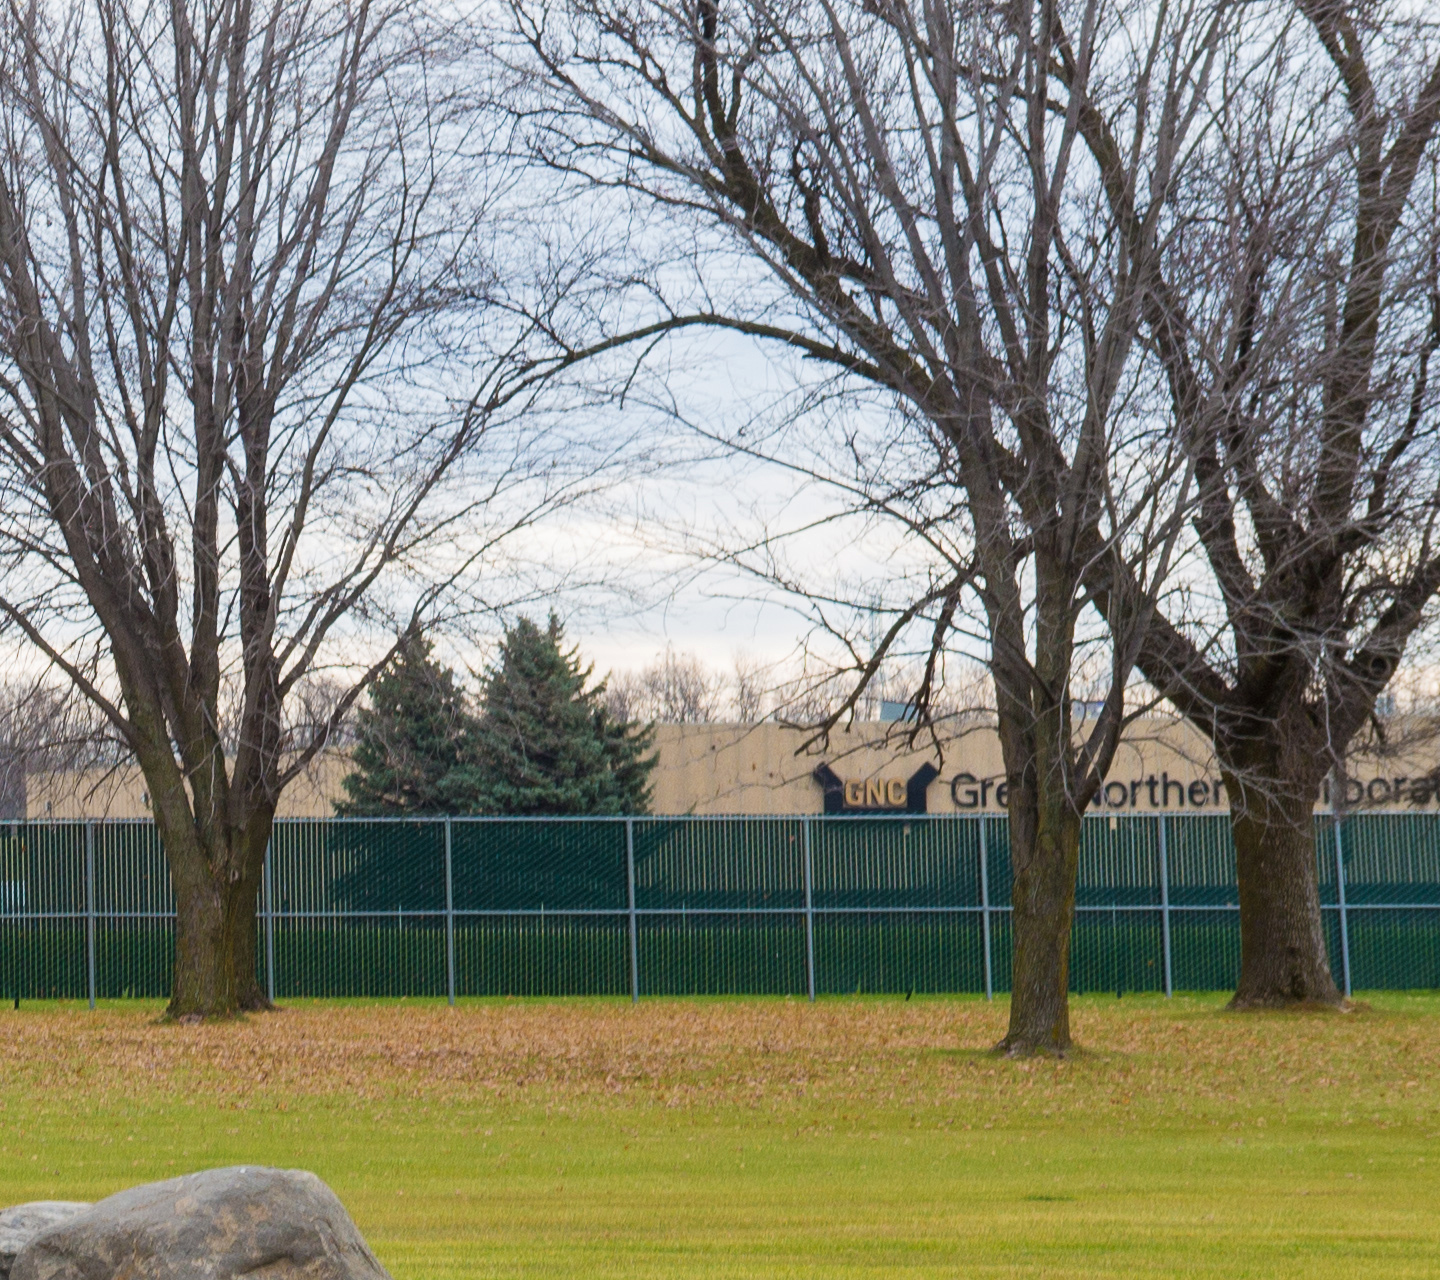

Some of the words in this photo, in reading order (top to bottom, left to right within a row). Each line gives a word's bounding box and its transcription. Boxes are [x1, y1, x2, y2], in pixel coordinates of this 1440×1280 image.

[844, 777, 907, 807] GNC
[951, 772, 1009, 808] Gre
[1091, 771, 1225, 807] orther
